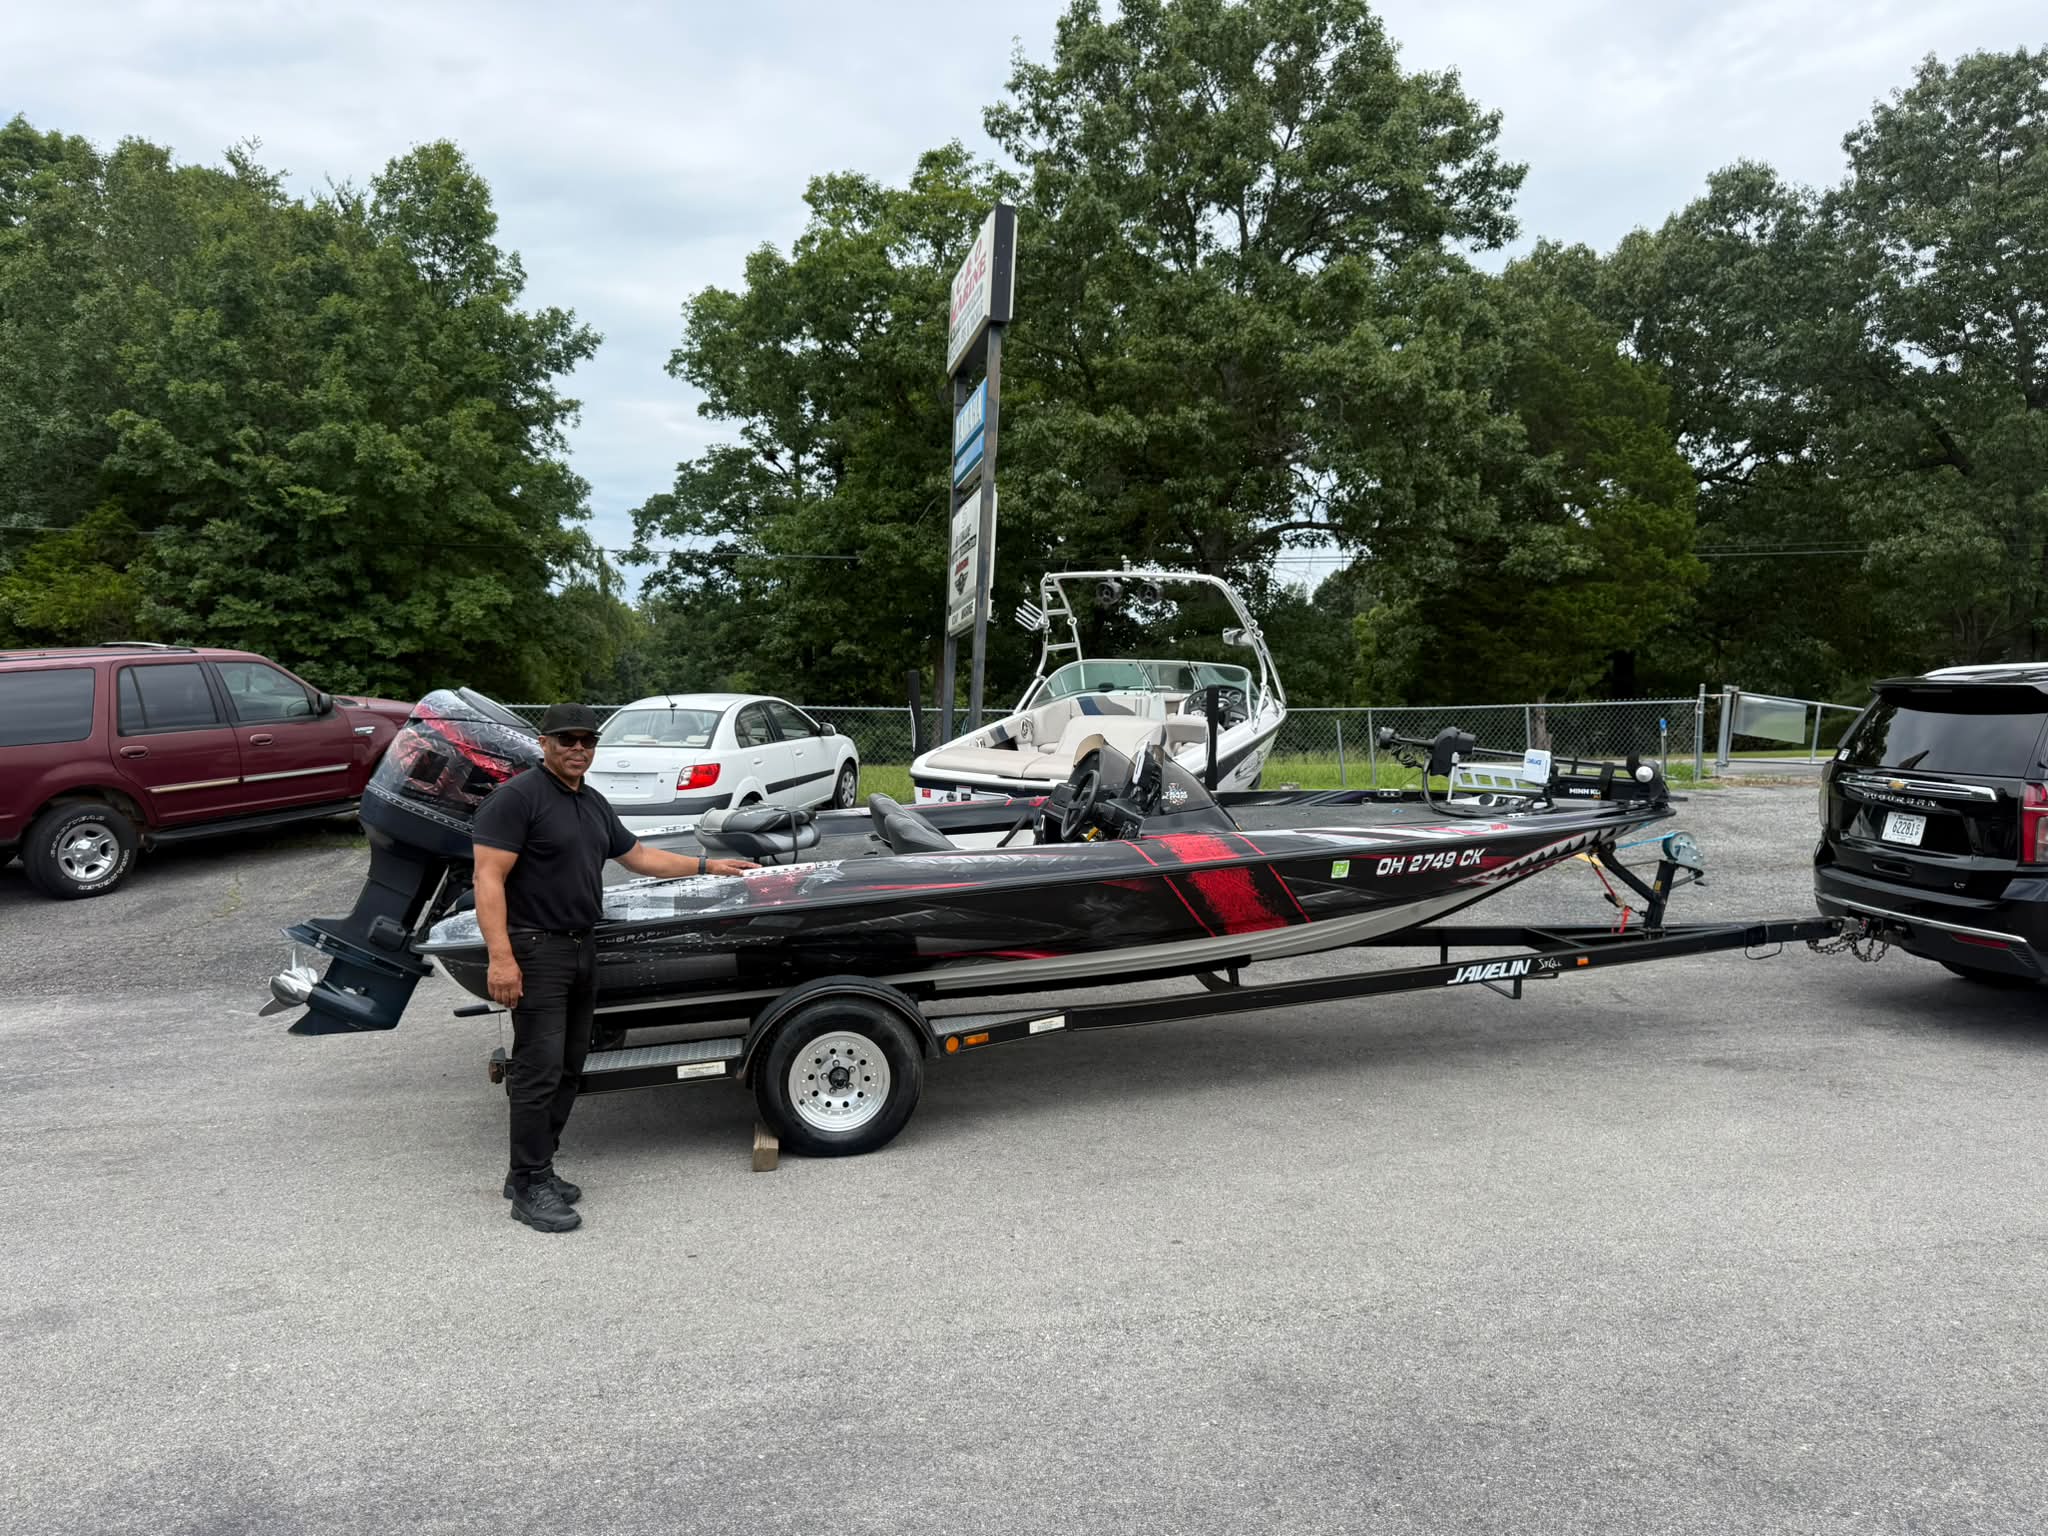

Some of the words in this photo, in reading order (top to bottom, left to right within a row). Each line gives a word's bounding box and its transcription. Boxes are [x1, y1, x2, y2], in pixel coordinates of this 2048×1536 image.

[1376, 857, 1406, 876] OH
[1408, 851, 1457, 872] 2749
[1459, 848, 1487, 866] CK
[1447, 959, 1532, 984] JAVELIN
